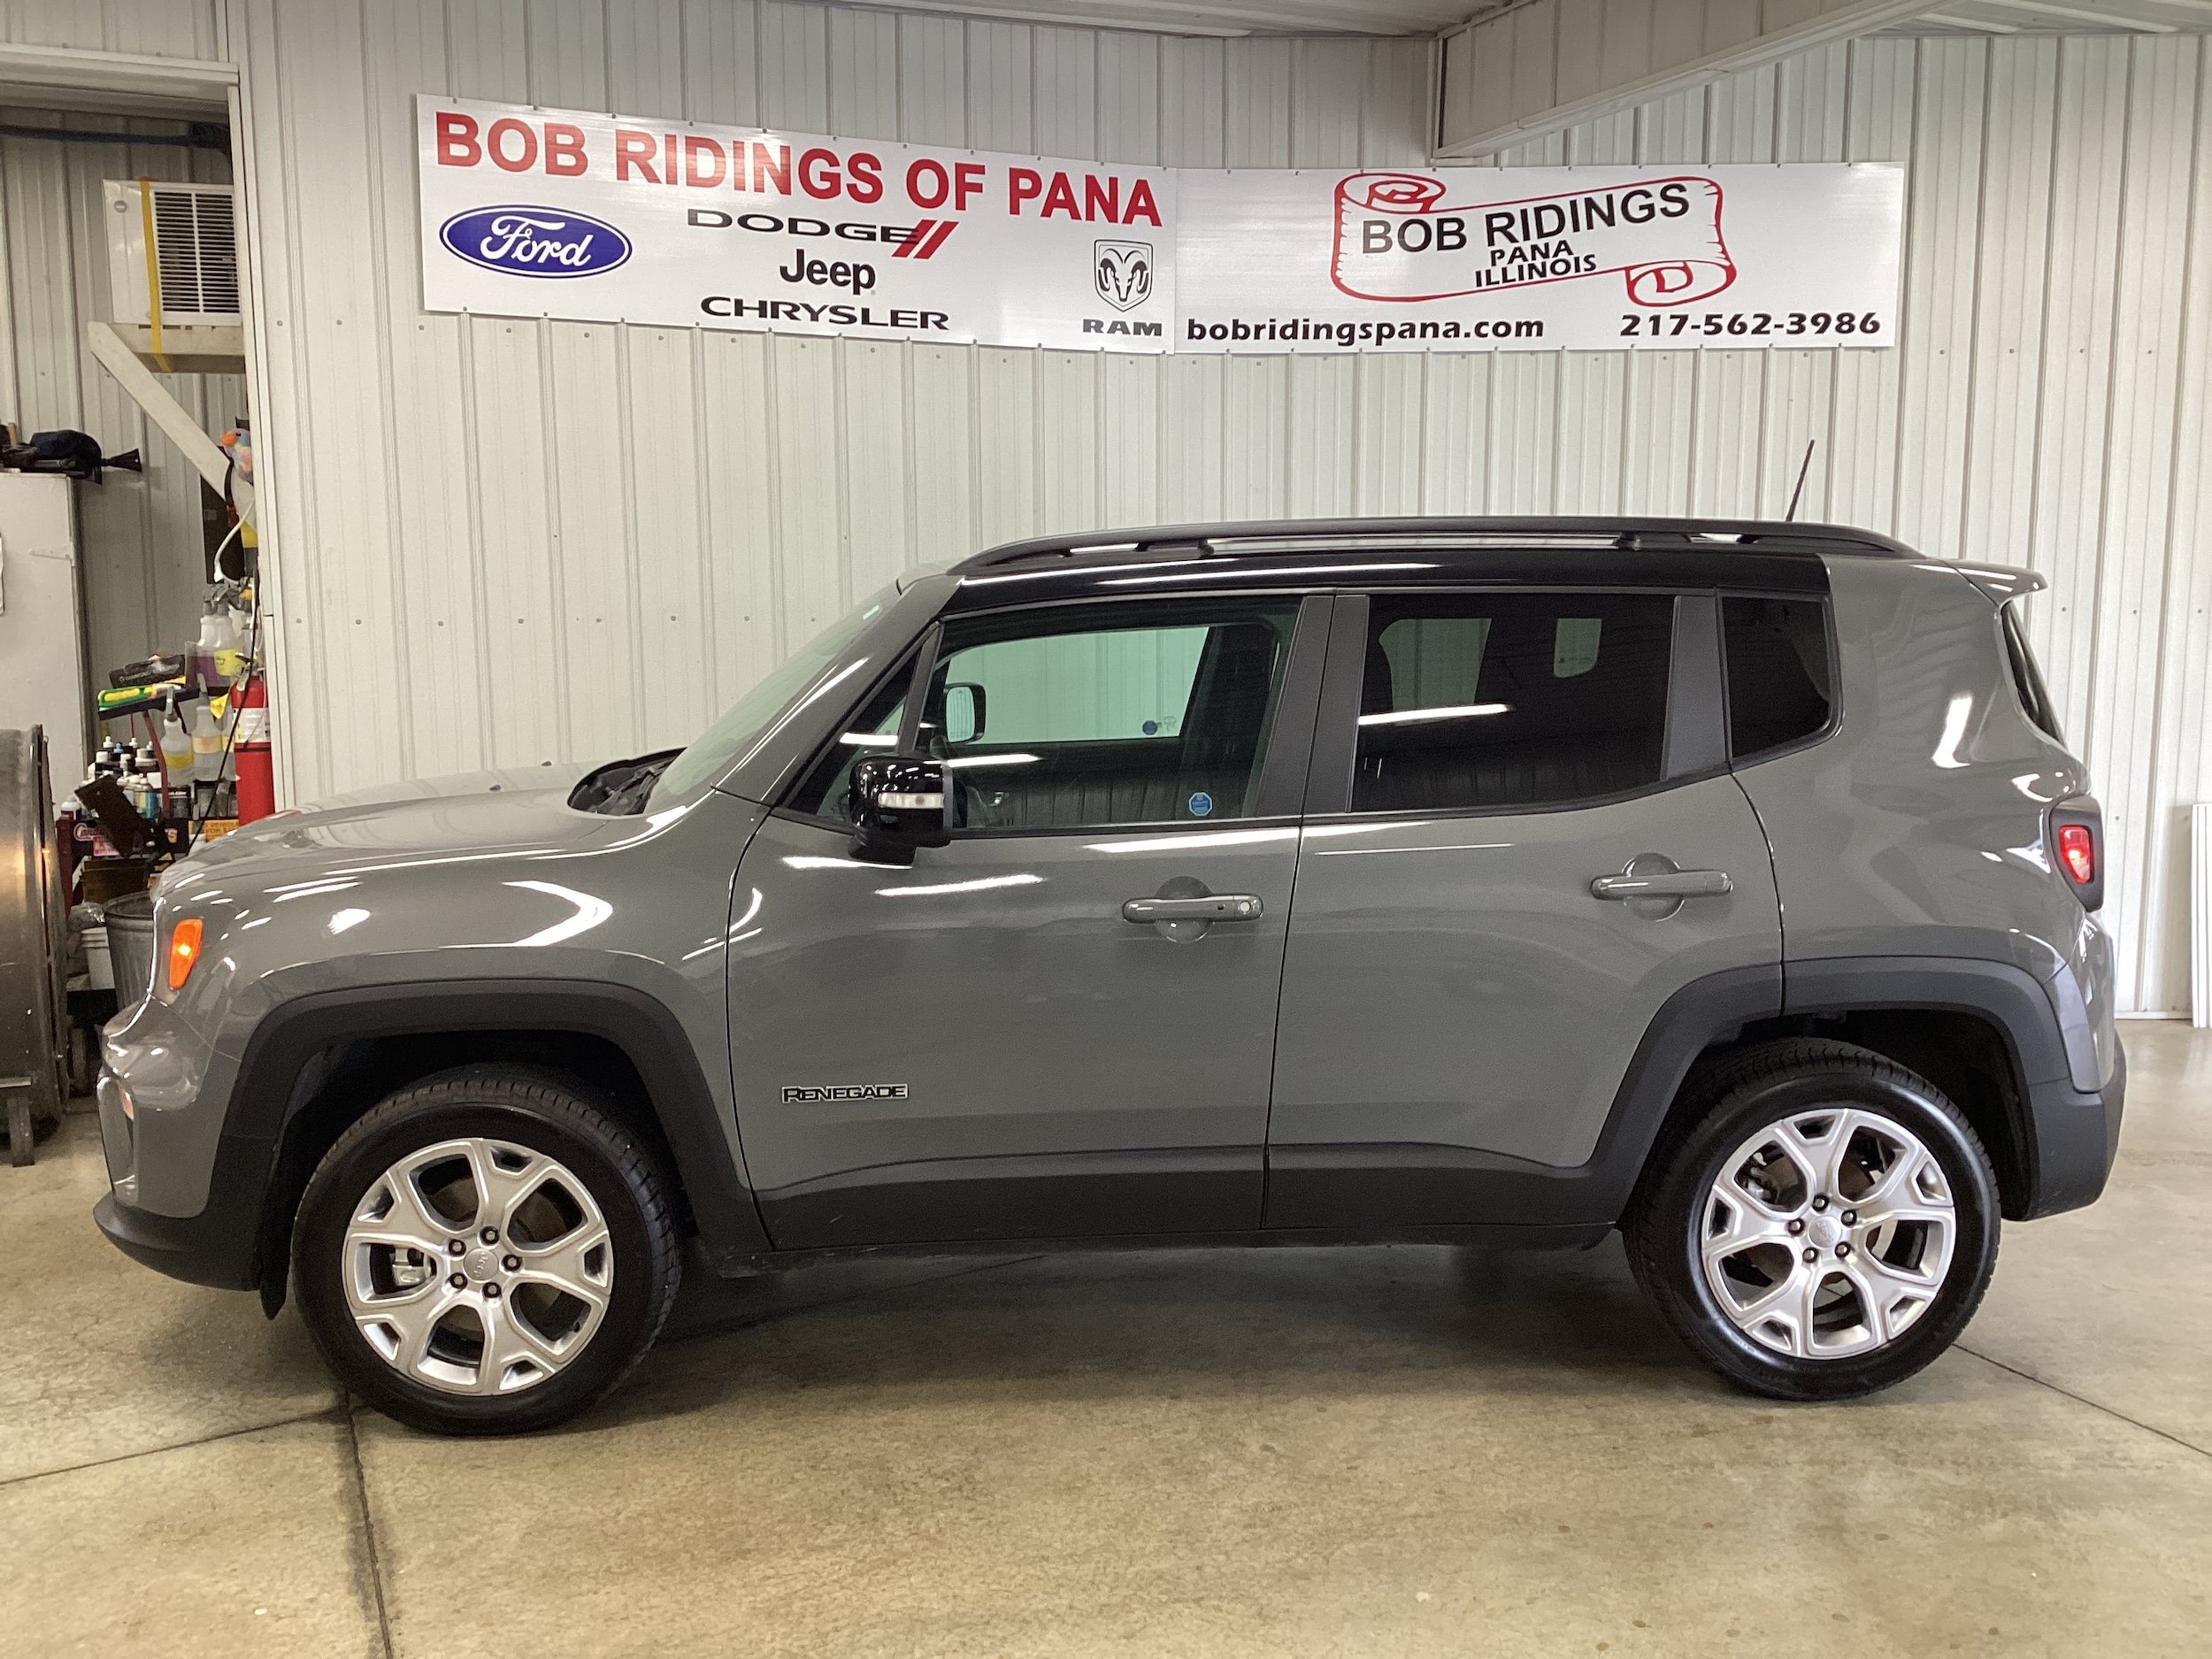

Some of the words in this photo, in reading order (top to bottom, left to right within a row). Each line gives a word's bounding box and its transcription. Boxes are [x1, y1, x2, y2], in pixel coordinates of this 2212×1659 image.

[435, 111, 588, 177] BOB
[616, 129, 885, 204] RIDINGS
[905, 158, 986, 211] OF
[1009, 167, 1163, 227] PANA
[687, 208, 921, 245] DODGE
[1363, 217, 1468, 255] BOB
[1485, 182, 1690, 247] RIDINGS
[480, 215, 595, 267] Ford
[1490, 239, 1574, 267] PANA
[779, 248, 877, 296] Jeep
[1475, 253, 1597, 288] ILLINOIS
[700, 296, 949, 331] CHRYSLER
[1082, 319, 1164, 337] RAM
[1620, 312, 1882, 337] 217-562-3986
[1187, 318, 1545, 347] bobridingspana.com
[781, 1084, 909, 1103] RENEGADE
